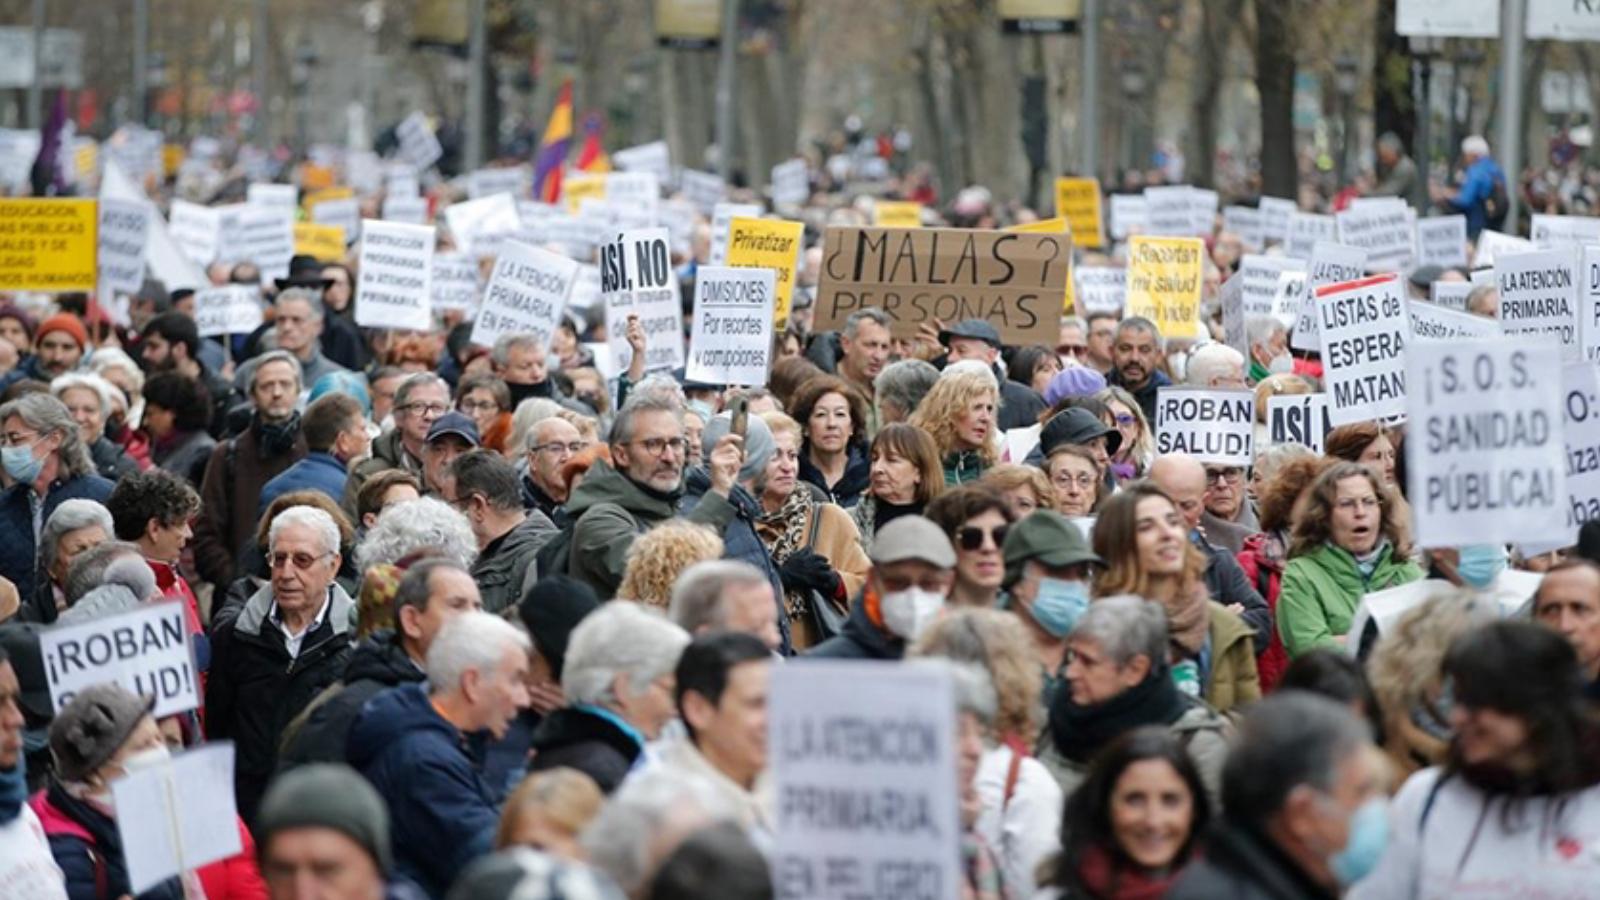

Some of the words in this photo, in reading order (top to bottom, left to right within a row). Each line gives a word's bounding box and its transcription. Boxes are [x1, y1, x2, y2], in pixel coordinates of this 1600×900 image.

[732, 229, 794, 253] Privatizar
[635, 239, 668, 288] NO
[1519, 265, 1571, 290] ATENCIÓN
[1154, 272, 1198, 293] salud
[703, 312, 721, 335] Por
[722, 315, 762, 335] recortes
[1322, 294, 1379, 330] LISTAS
[1382, 292, 1400, 318] de
[1501, 297, 1573, 320] PRIMARIA,
[1328, 330, 1404, 369] ESPERA
[1334, 369, 1407, 408] MATAN
[1158, 398, 1250, 427] ¡ROBAN
[1157, 432, 1250, 456] SALUD!
[1427, 410, 1550, 454] SANIDAD
[1427, 464, 1555, 513] PÚBLICA!
[47, 614, 184, 685] ¡ROBAN
